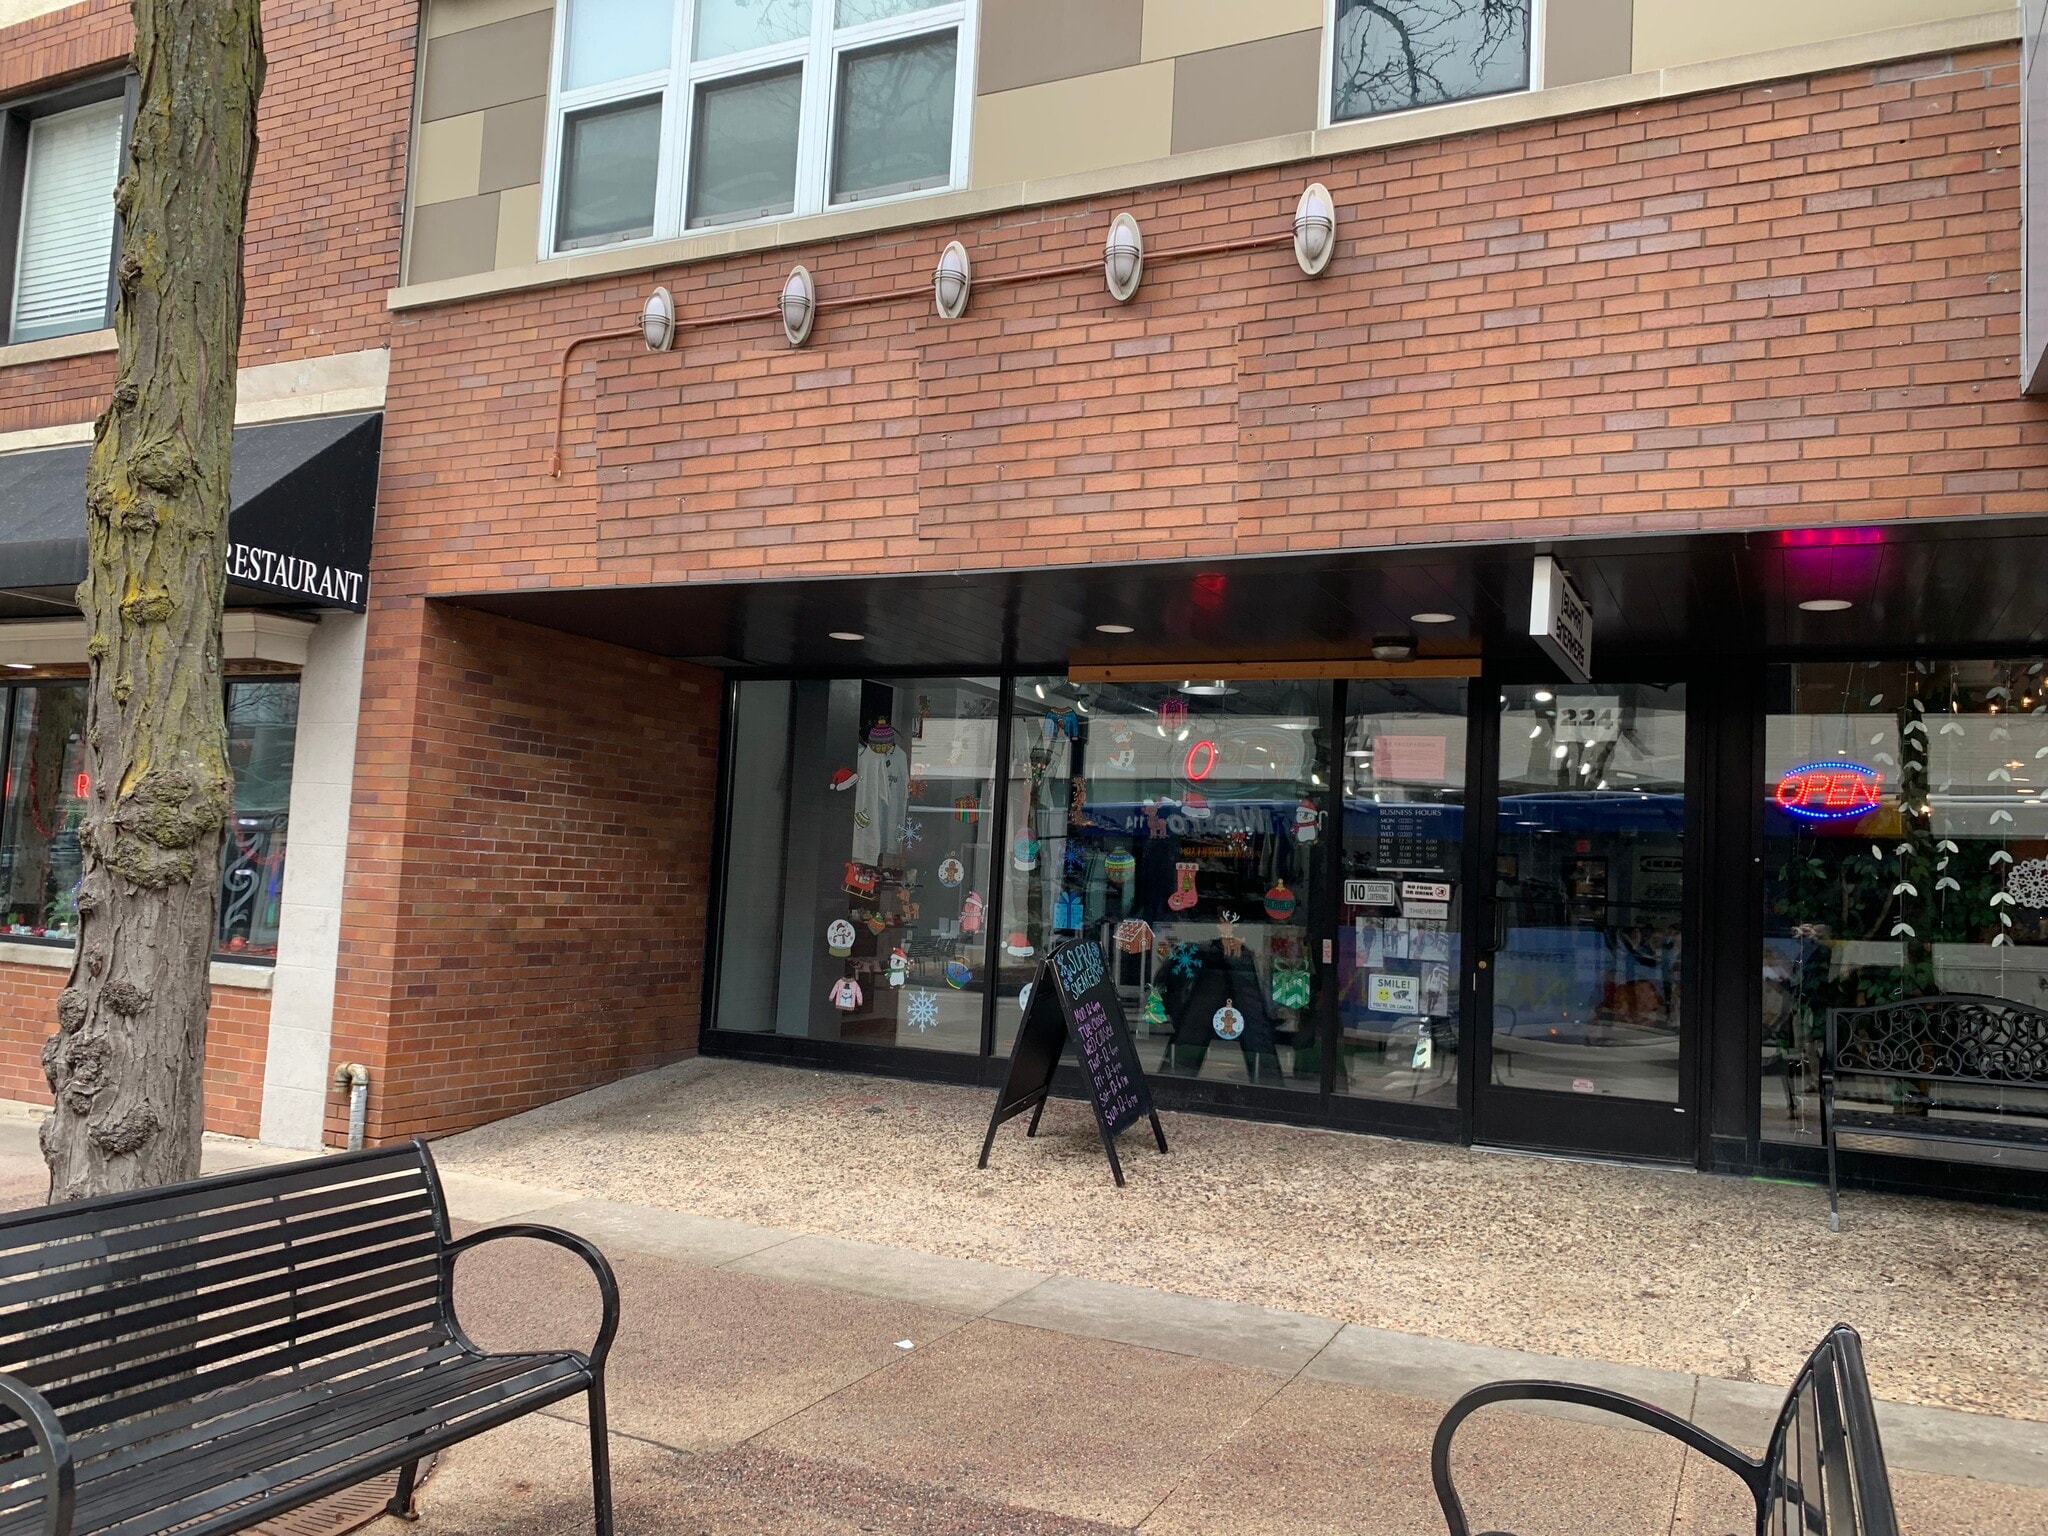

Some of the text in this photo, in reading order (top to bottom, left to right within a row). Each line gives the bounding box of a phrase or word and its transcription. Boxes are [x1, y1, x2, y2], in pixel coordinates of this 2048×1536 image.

[1560, 708, 1614, 730] 224
[1776, 774, 1884, 805] OPEN
[1379, 808, 1413, 816] BUSINESS
[1350, 884, 1365, 900] NO
[1067, 942, 1095, 974] SUPRA
[1071, 965, 1101, 1000] SNEAKERS
[1378, 979, 1410, 989] SMILE!
